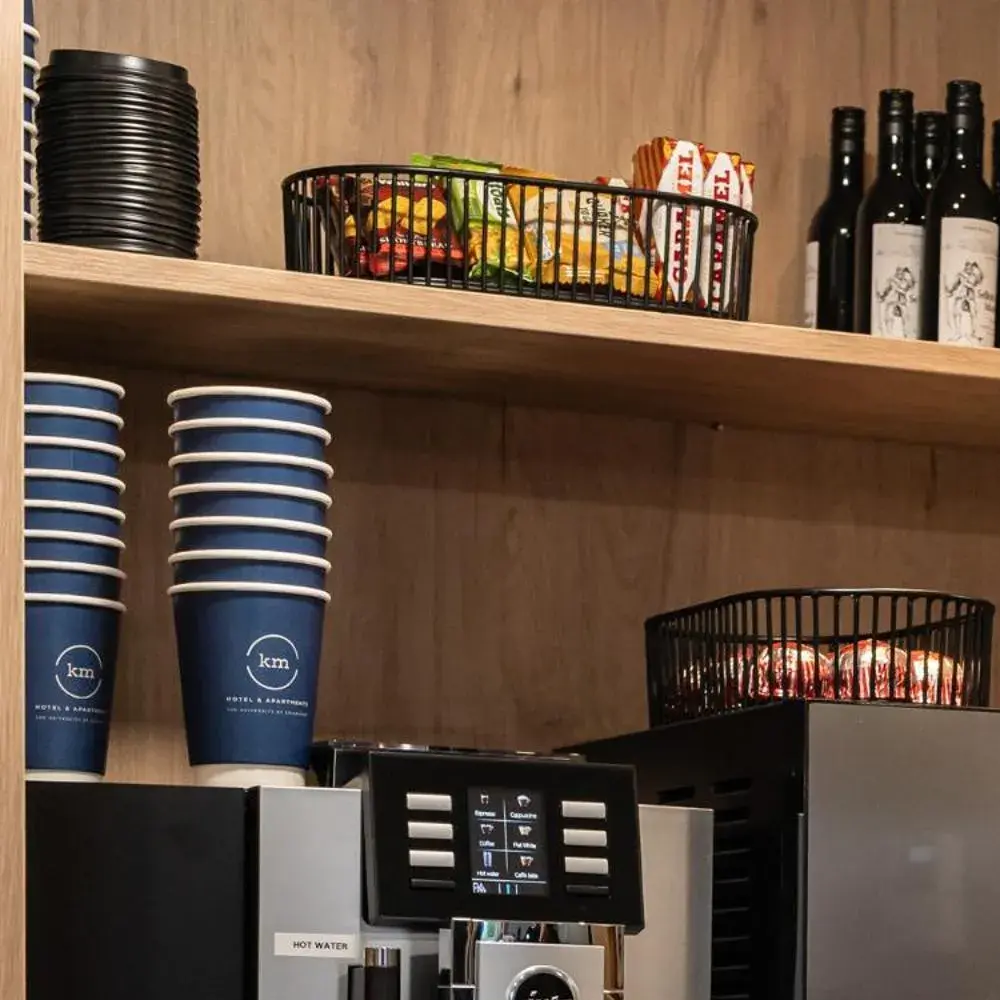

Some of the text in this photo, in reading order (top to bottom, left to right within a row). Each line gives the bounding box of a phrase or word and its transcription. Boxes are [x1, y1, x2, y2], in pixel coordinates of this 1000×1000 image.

[258, 652, 290, 670] km
[67, 662, 94, 679] km
[293, 941, 348, 950] HOT WATER
